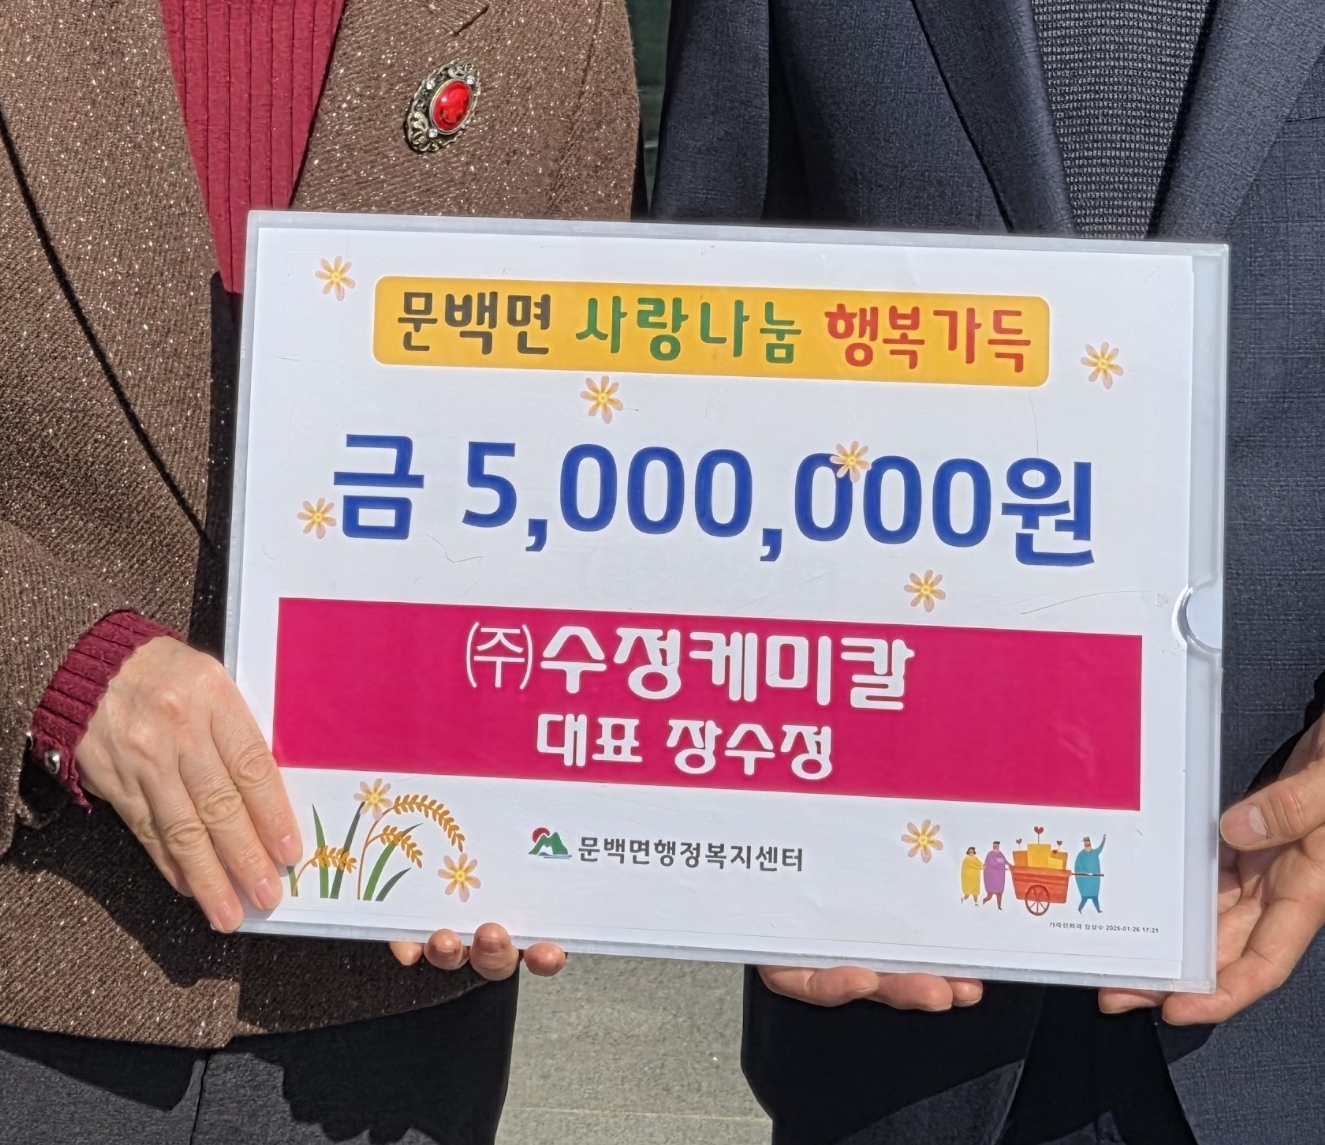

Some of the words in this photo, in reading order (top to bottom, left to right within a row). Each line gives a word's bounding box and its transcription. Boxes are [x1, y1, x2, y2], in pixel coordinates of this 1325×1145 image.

[397, 287, 552, 357] 문백면
[574, 294, 803, 366] 사랑나눔
[824, 301, 1035, 374] 행복가득
[331, 432, 425, 542] 금
[461, 439, 1095, 567] 5,000,000원
[465, 621, 916, 711] (주)수정케미칼
[535, 711, 643, 768] 대표
[665, 715, 835, 782] 장수정
[578, 835, 805, 873] 문백면행정복지센터
